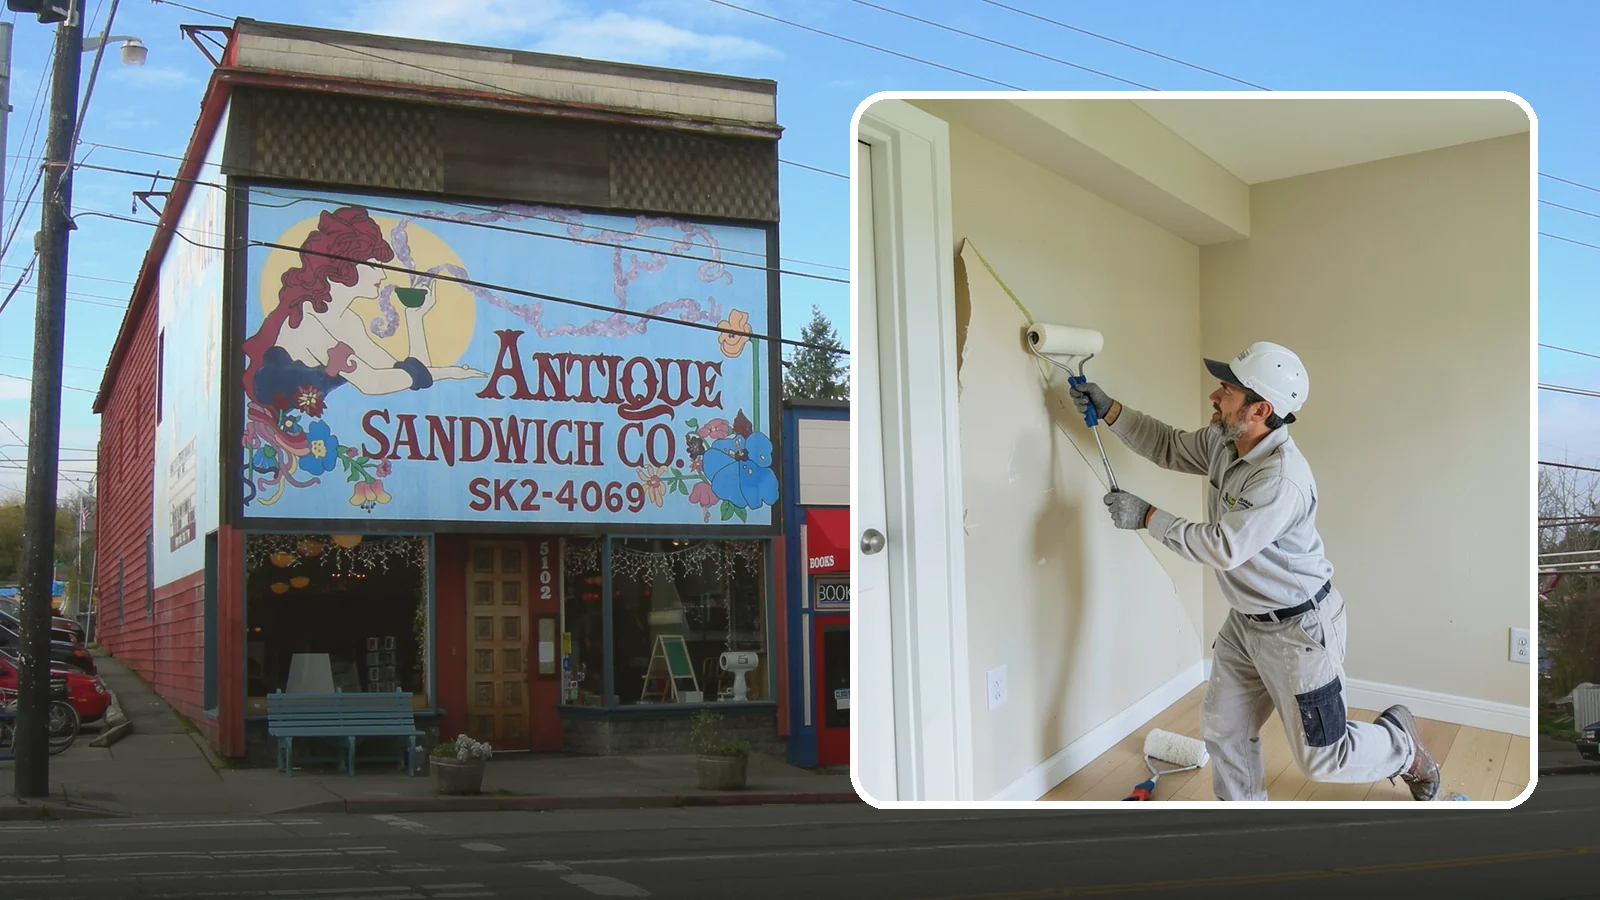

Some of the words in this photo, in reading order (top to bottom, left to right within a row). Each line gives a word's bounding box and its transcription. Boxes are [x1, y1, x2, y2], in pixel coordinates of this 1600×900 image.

[476, 328, 724, 420] ANTIQUE
[361, 408, 604, 468] SANDWICH
[617, 420, 685, 469] CO.
[468, 477, 646, 513] SK2-4069
[539, 541, 552, 600] 5102
[809, 555, 835, 569] BOOKS
